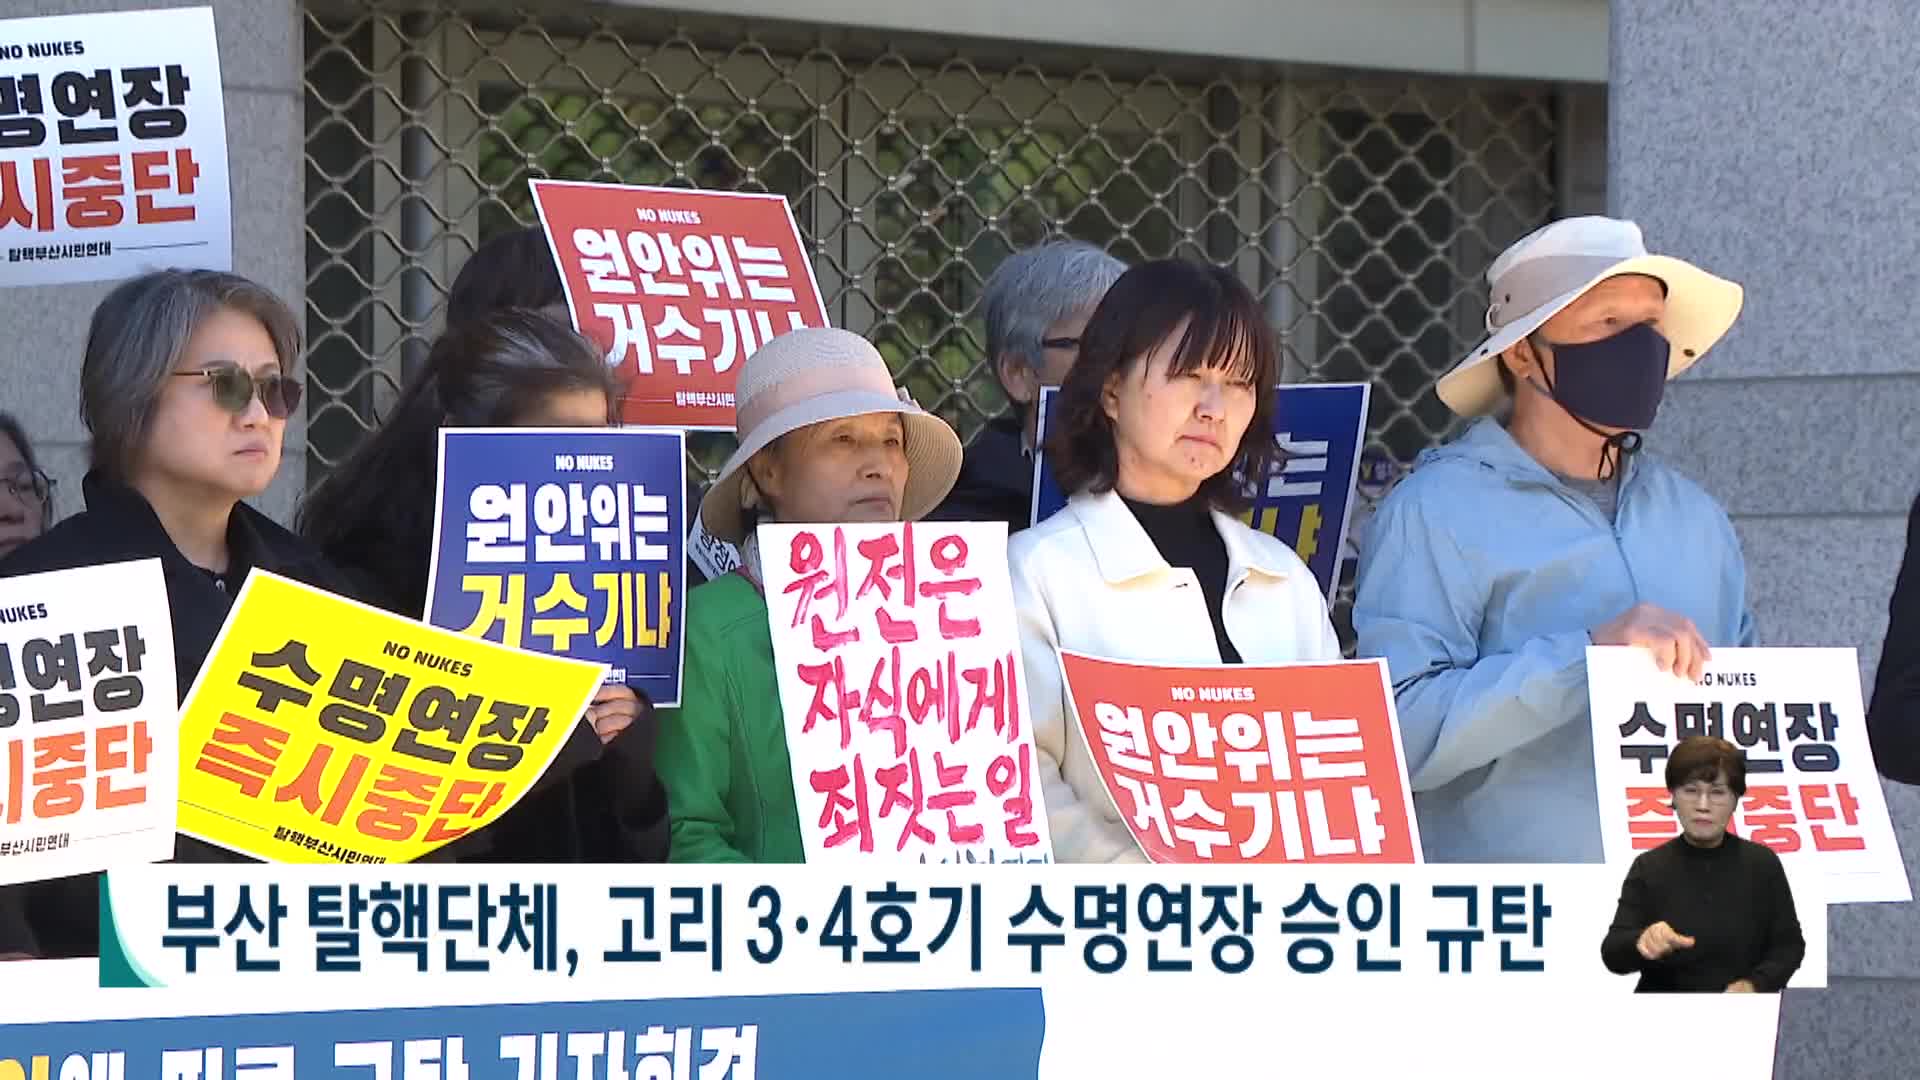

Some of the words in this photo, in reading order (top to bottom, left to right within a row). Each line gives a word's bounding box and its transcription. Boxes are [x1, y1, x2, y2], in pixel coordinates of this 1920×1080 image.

[28, 40, 85, 58] NUKES
[636, 207, 656, 222] NO
[659, 210, 701, 224] NUKES
[572, 228, 796, 303] 원안위는
[555, 455, 574, 470] NO
[577, 455, 613, 470] NUKES
[466, 483, 668, 562] 원안위는
[457, 572, 672, 651] 거수기냐
[782, 521, 983, 652] 원전은
[383, 640, 411, 662] NO
[414, 648, 473, 677] NUKES
[1171, 687, 1195, 700] NO
[1199, 688, 1256, 701] NUKES
[1695, 672, 1713, 686] O
[1717, 672, 1757, 686] NUKES
[237, 639, 549, 772] 수명연장
[797, 645, 1020, 758] 자식에게
[195, 711, 507, 842] 즉시중단
[1095, 702, 1367, 782] 원안위는
[1113, 773, 1386, 860] 거수기냐
[1625, 783, 1866, 854] 즉중단
